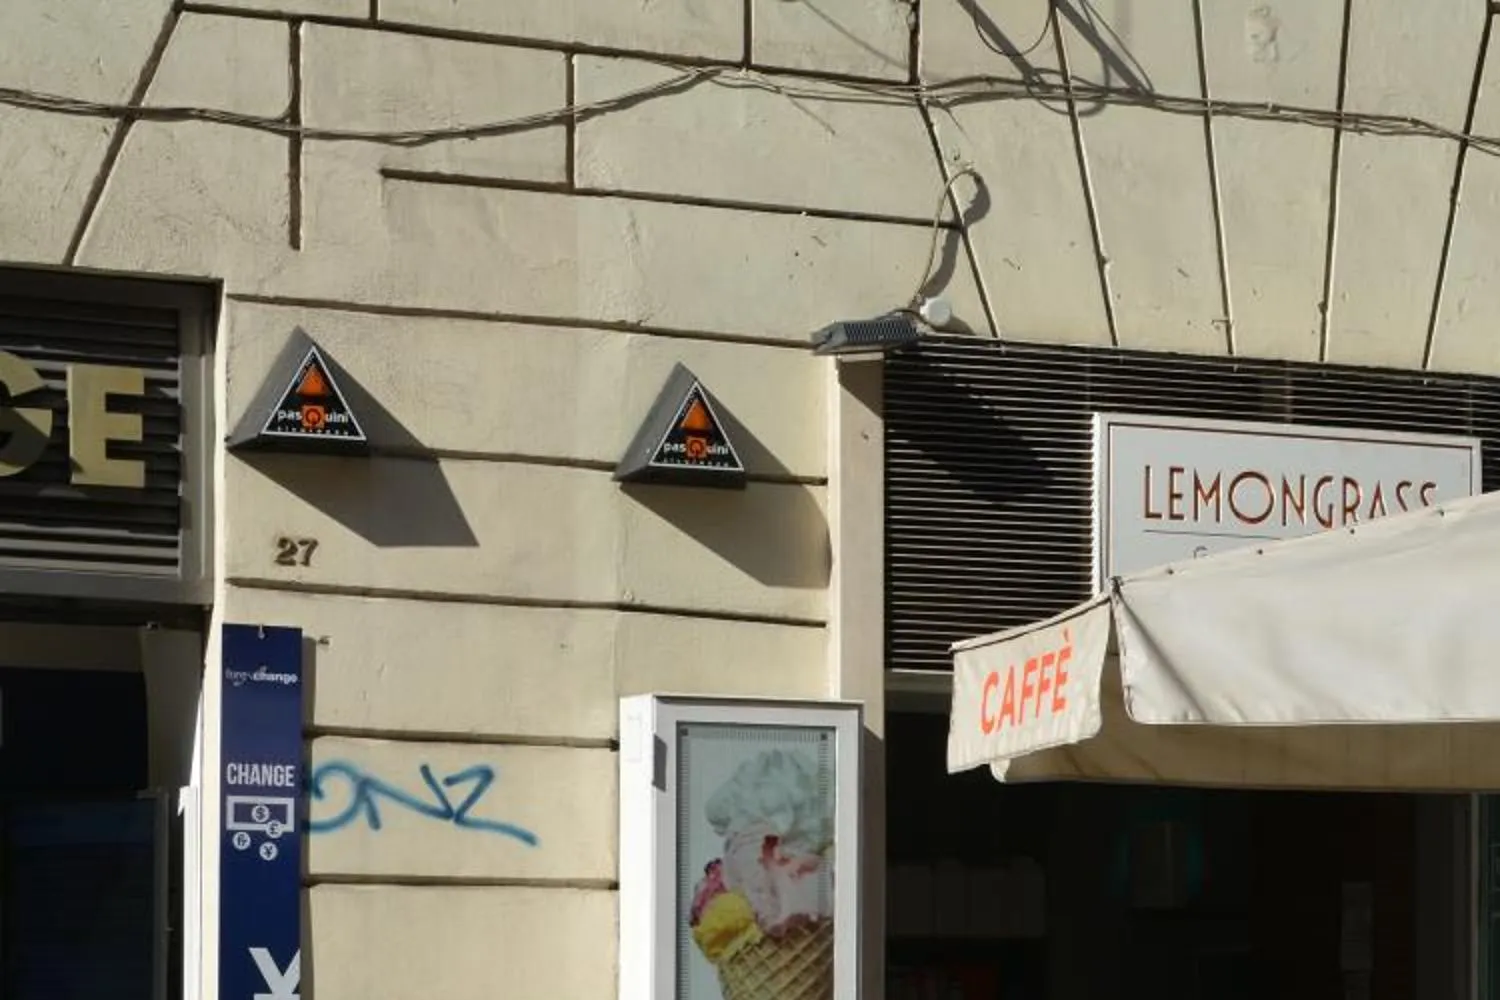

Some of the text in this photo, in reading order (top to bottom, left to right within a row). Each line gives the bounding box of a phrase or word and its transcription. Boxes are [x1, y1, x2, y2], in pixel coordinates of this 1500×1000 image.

[273, 537, 319, 567] 27
[981, 627, 1072, 735] CAFFÈ
[226, 762, 296, 787] CHANGE
